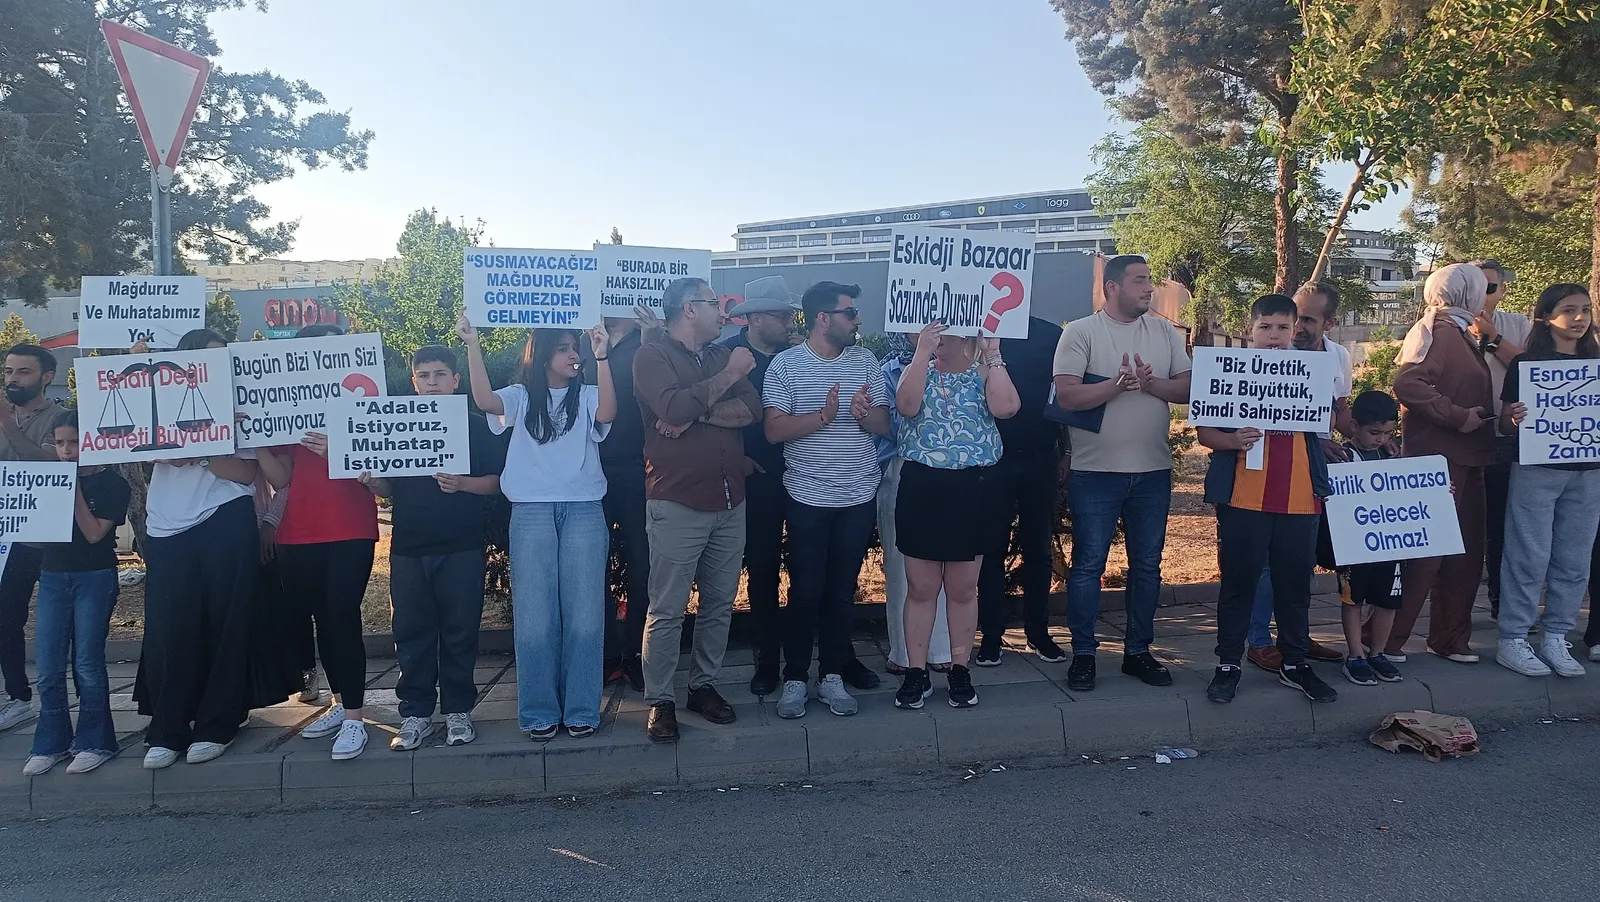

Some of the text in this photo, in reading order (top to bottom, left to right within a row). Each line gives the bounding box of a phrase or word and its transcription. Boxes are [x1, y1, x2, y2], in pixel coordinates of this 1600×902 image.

[1045, 198, 1069, 208] Togg
[893, 234, 1032, 272] Eskidji Bazaar
[616, 260, 688, 275] “BURADA BİR
[108, 281, 180, 299] Mağduruz
[487, 270, 579, 291] MAĞDURUZ,
[606, 276, 666, 290] HAKSIZLIK
[484, 288, 581, 306] GÖRMEZDEN
[889, 278, 985, 327] Sözünde Dursun!
[85, 304, 200, 319] Ve Muhatabımız
[487, 308, 579, 324] GELMEYİN!”
[128, 328, 155, 342] Yok
[233, 346, 378, 380] Bugün Bizi Yarın Sizi
[1215, 355, 1311, 380] "Biz Ürettik,
[97, 362, 209, 391] Esnafı Değil
[1529, 365, 1589, 383] Esnaf
[236, 381, 342, 408] Dayanışmaya
[1209, 378, 1313, 403] Biz Büyüttük,
[355, 400, 438, 415] "Adalet
[1191, 400, 1330, 424] Şimdi Sahipsiziz!"
[239, 411, 326, 440] Çağırıyoruz
[347, 417, 448, 436] İstiyoruz,
[81, 427, 149, 452] Adaleti
[352, 437, 445, 452] Muhatap
[1548, 444, 1600, 460] Zam
[344, 454, 455, 472] İstiyoruz!"
[1, 466, 73, 491] İstiyoruz,
[1327, 471, 1448, 496] Birlik Olmazsa
[1353, 500, 1431, 526] Gelecek
[1364, 527, 1429, 552] Olmaz!
